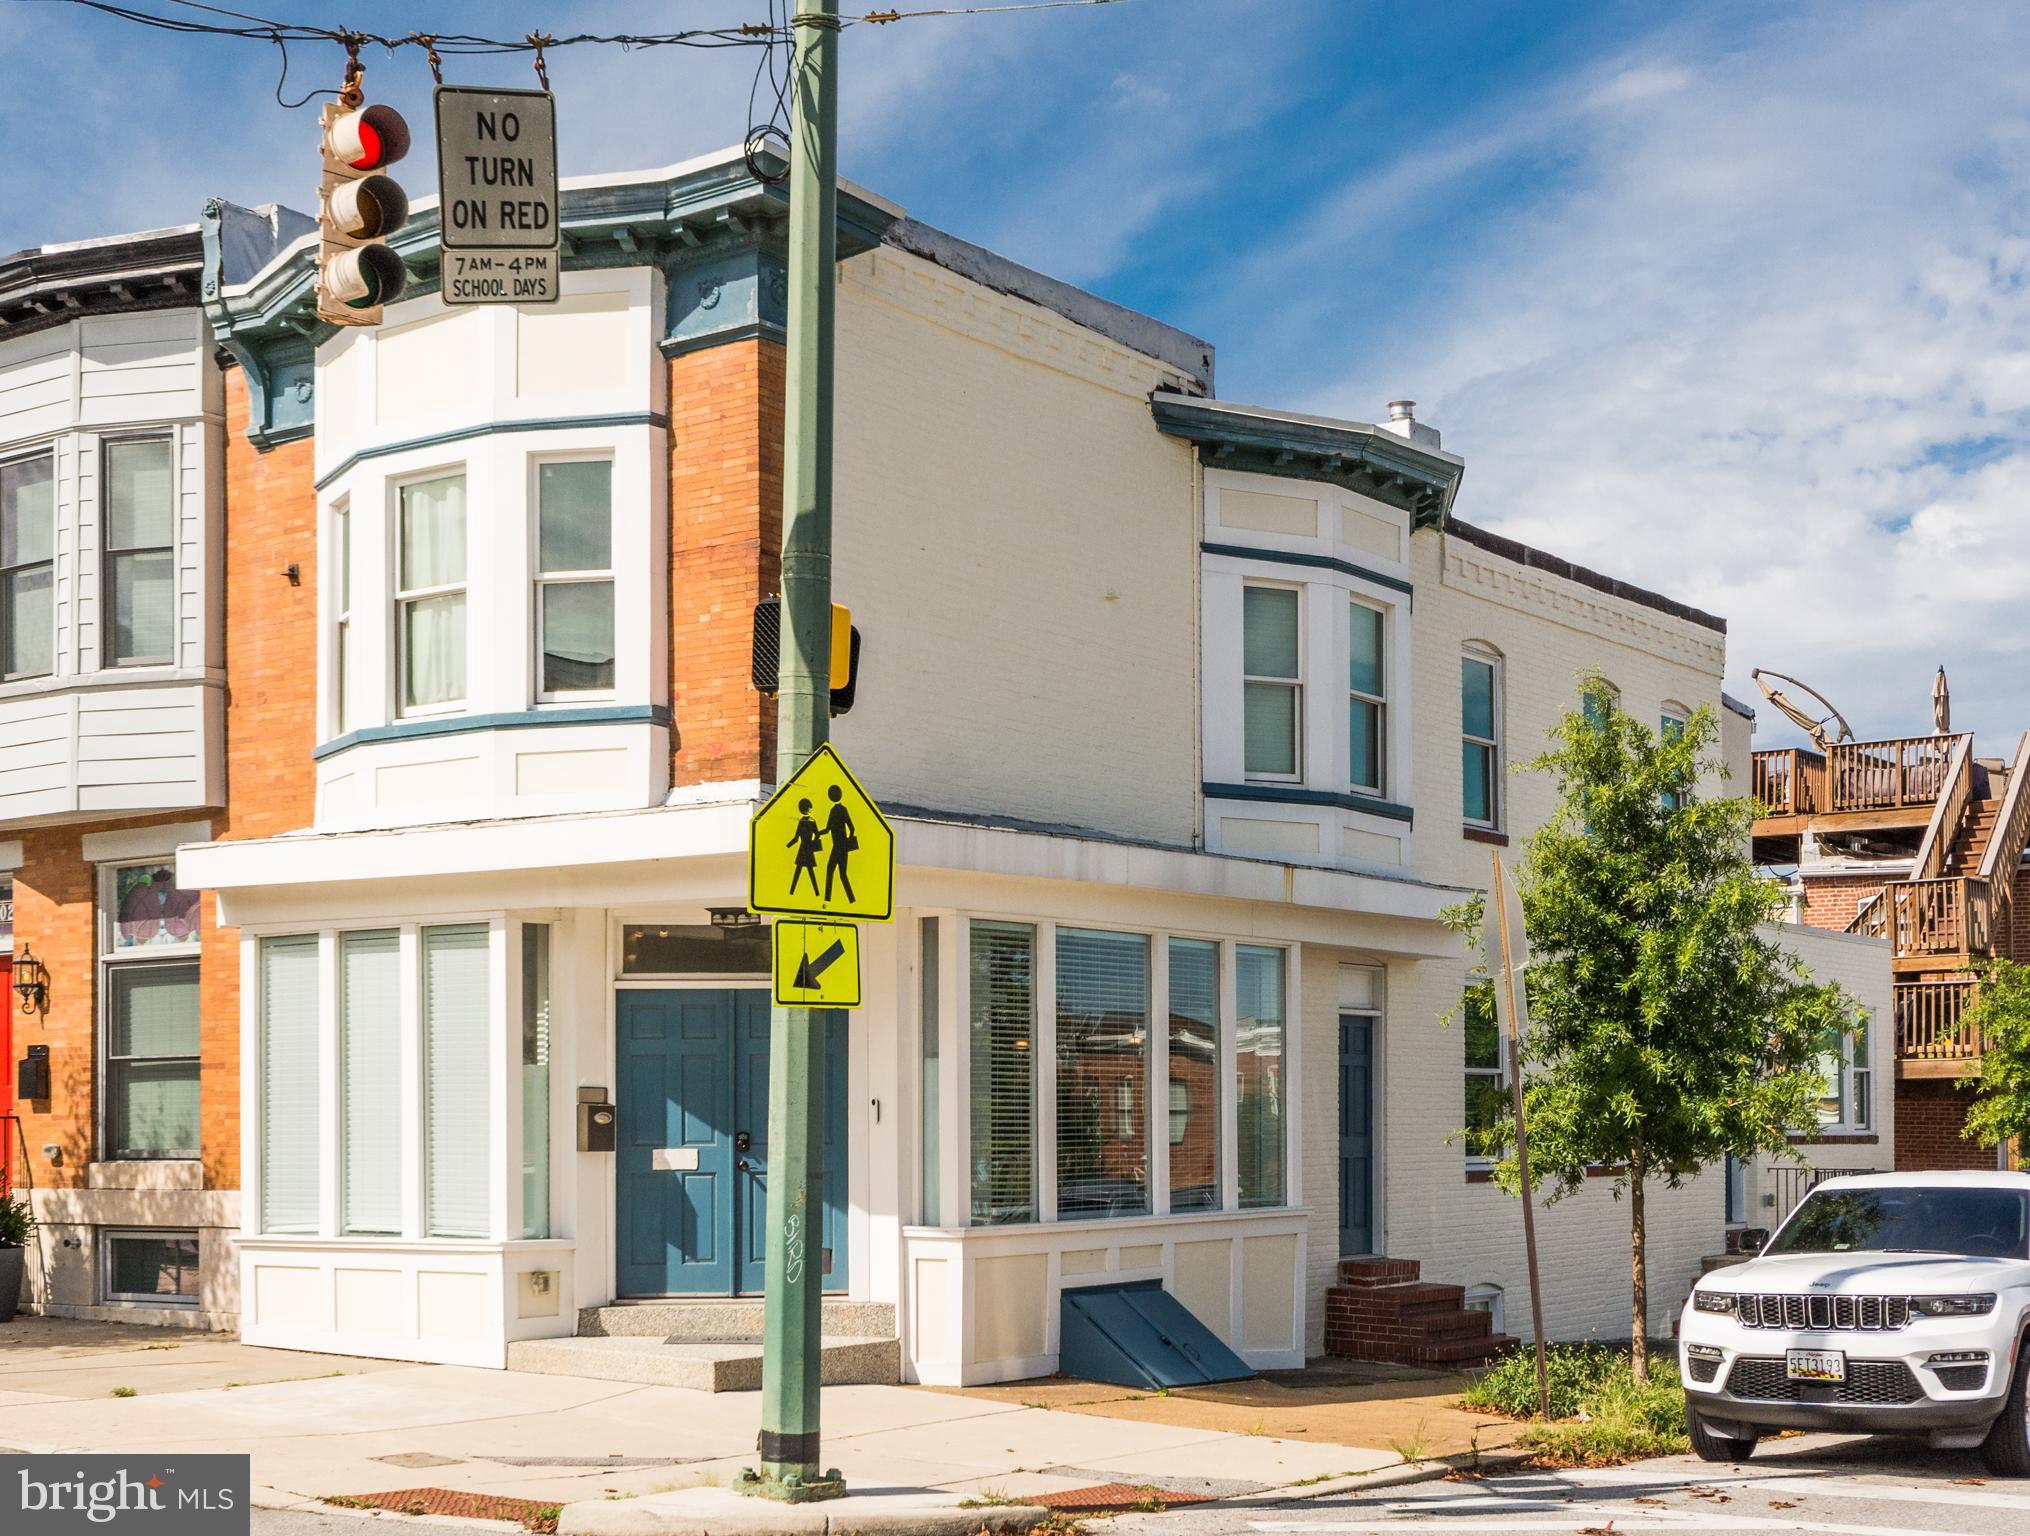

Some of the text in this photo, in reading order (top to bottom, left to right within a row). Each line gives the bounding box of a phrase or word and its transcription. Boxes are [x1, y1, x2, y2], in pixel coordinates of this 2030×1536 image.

[477, 112, 520, 141] NO
[465, 156, 534, 186] TURN
[452, 200, 549, 230] ON RED
[453, 278, 546, 297] SCHOOL DAYS
